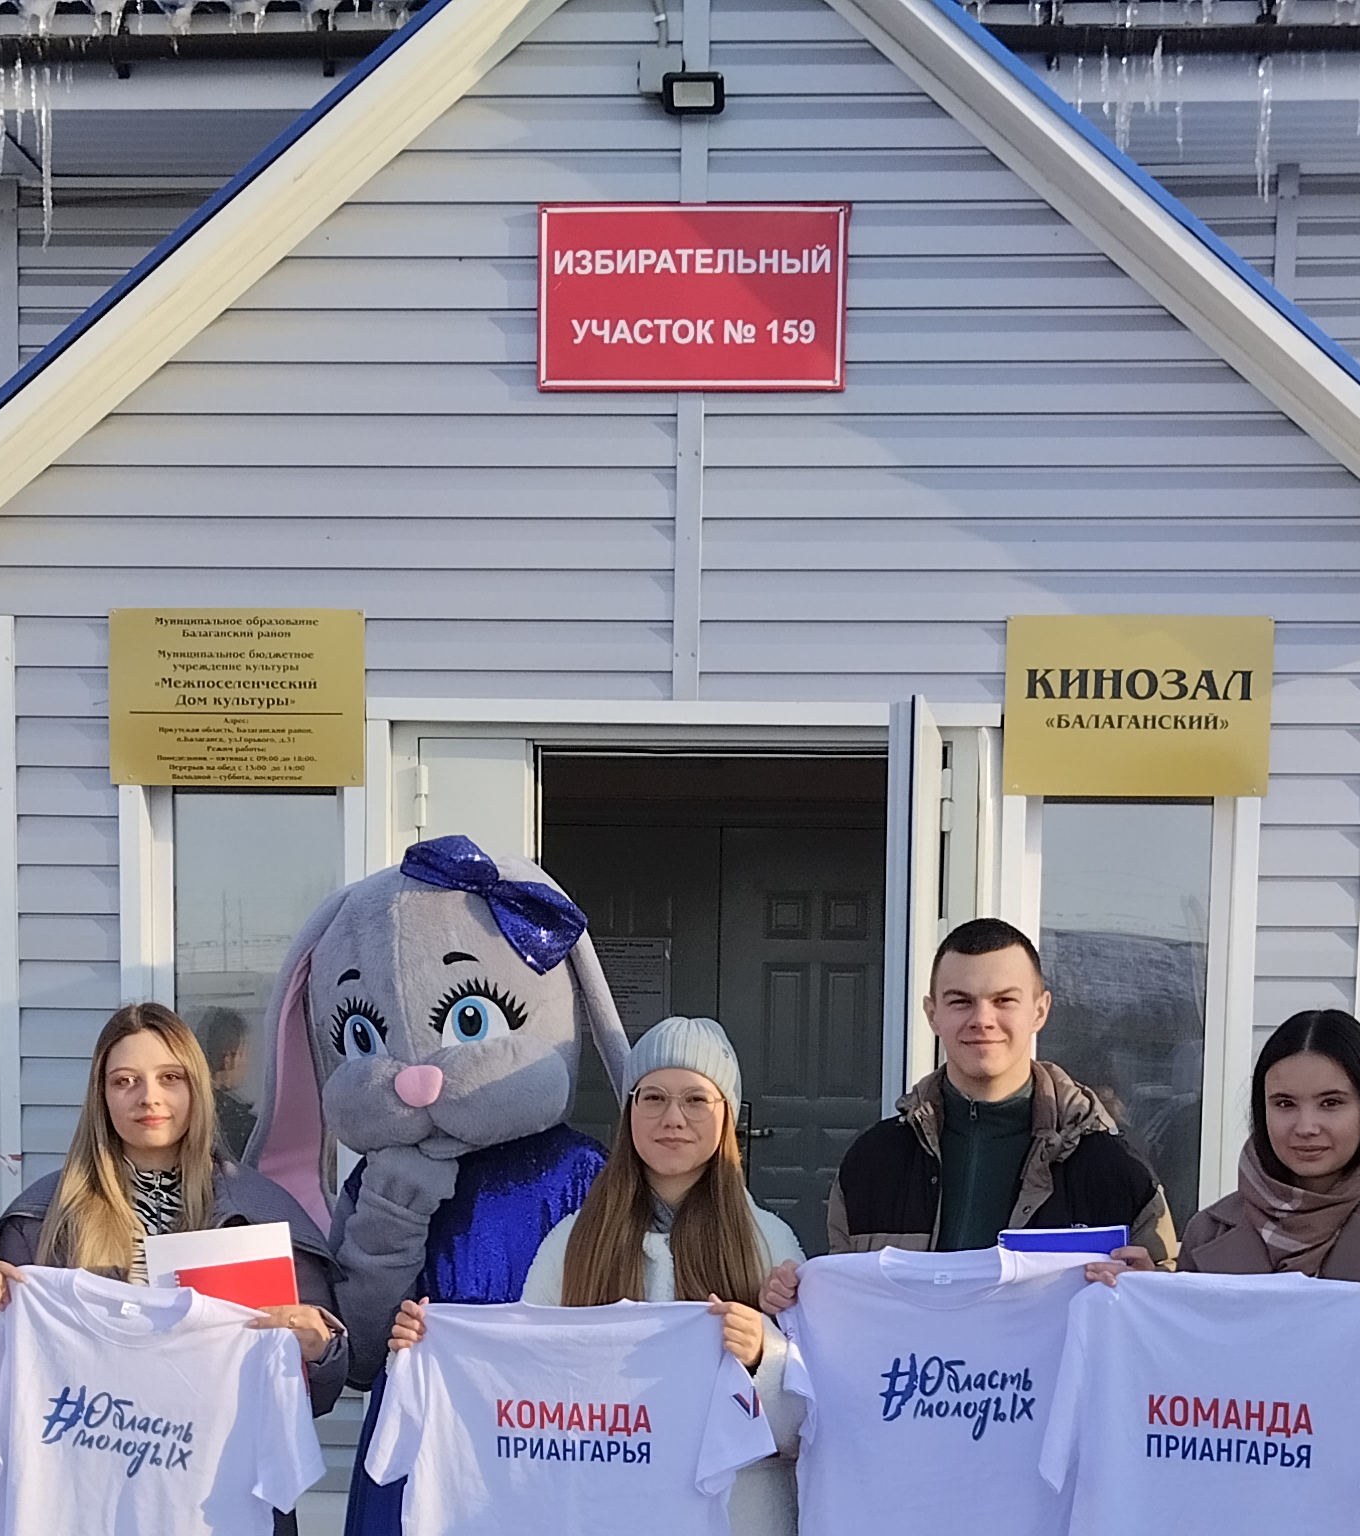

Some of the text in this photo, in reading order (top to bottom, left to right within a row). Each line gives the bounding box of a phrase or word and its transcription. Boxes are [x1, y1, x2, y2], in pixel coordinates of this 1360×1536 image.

[554, 244, 831, 275] ИЗБИРАТЕЛЬНЫЙ
[571, 319, 816, 345] УЧАСТОК № 159
[155, 616, 319, 627] Муниципальное образование
[182, 628, 291, 640] Балаганский район
[158, 649, 314, 660] Муниципальное бюджетное
[173, 664, 299, 673] учреждение культуры
[155, 677, 317, 689] «Межпоселенческий
[1025, 668, 1254, 701] КИНОЗАЛ
[175, 695, 295, 709] Дом культуры»
[1045, 712, 1229, 731] «БАЛАГАНСКИЙ»
[496, 1398, 652, 1437] КОМАНДА
[1147, 1394, 1313, 1438] КОМАНДА
[497, 1435, 652, 1464] ПРИАНГАРЬЯ
[1146, 1434, 1312, 1469] ПРИАНГАРЬЯ
